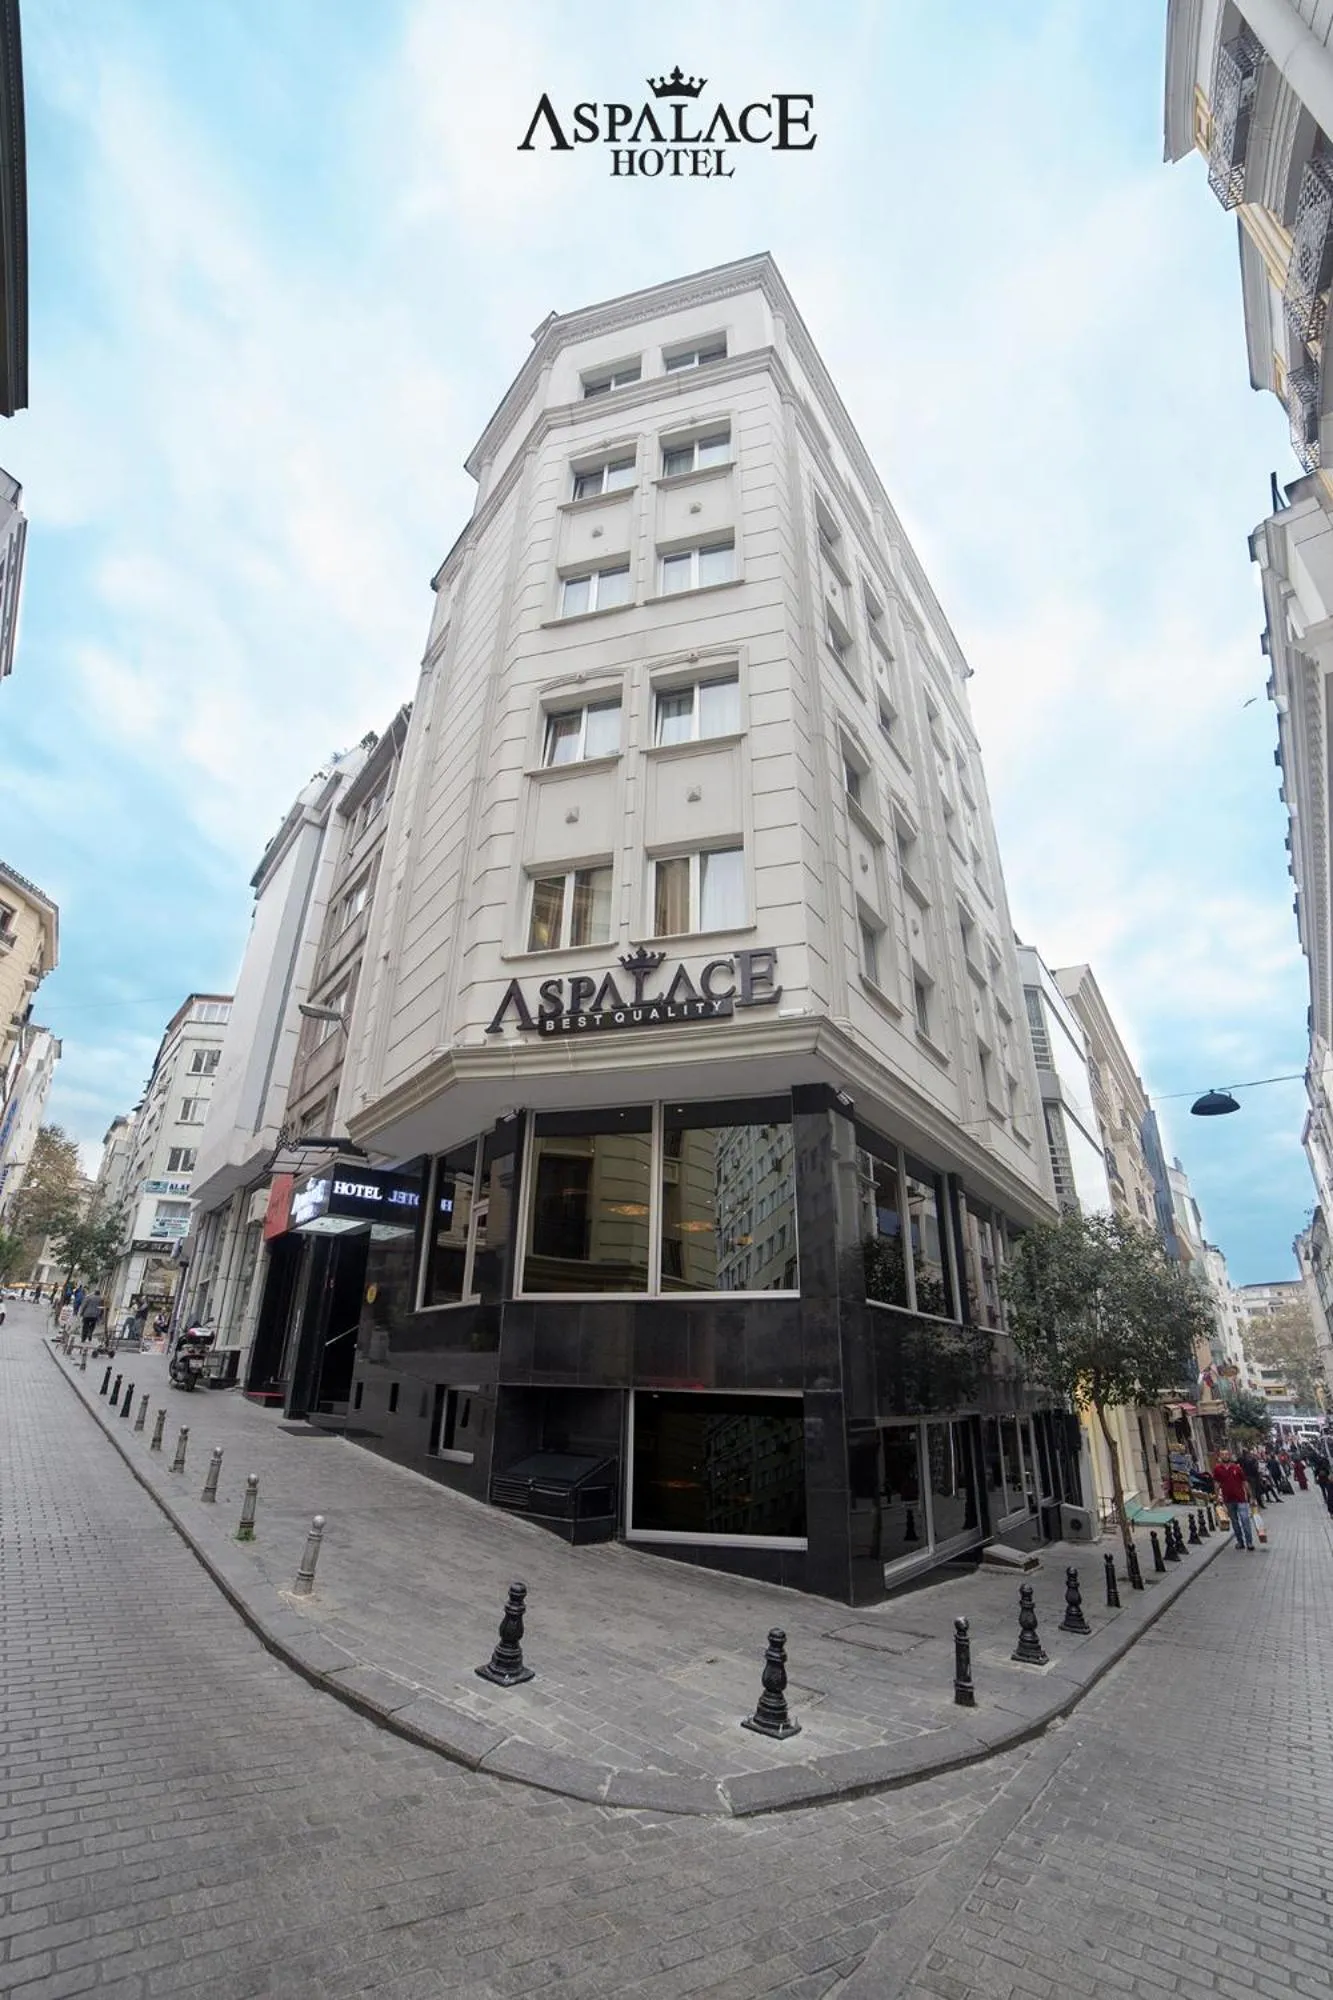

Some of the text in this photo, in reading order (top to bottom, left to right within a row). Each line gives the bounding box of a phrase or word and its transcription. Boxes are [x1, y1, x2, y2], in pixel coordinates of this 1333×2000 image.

[485, 948, 782, 1033] ASPALACE
[545, 1001, 722, 1031] BEST QUALITY
[333, 1180, 383, 1200] HOTEL
